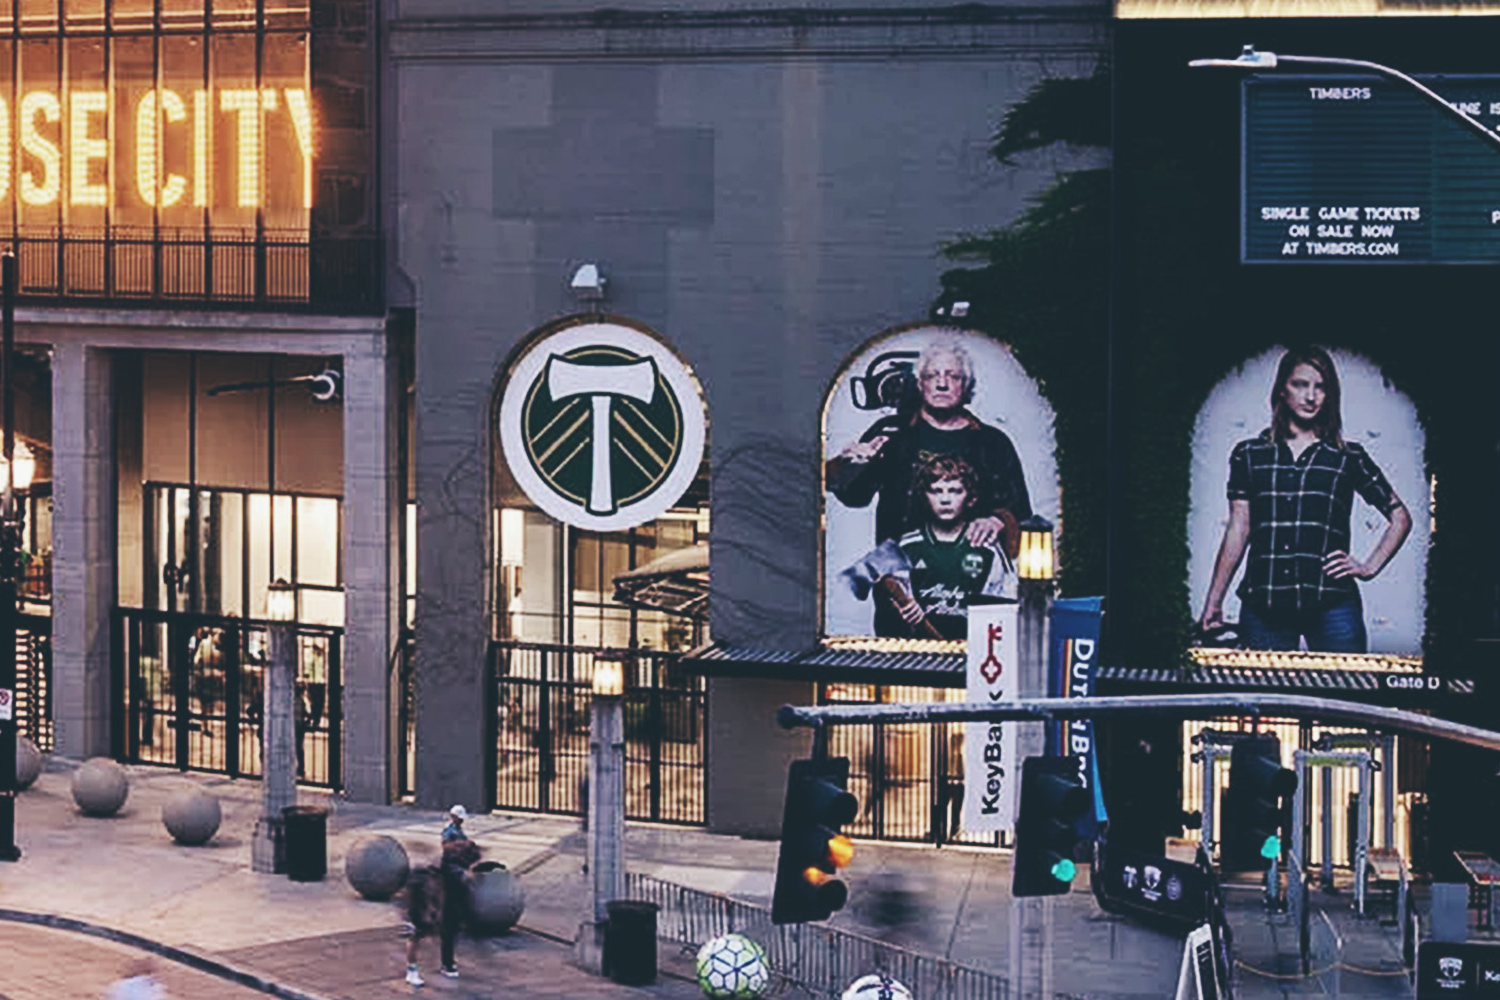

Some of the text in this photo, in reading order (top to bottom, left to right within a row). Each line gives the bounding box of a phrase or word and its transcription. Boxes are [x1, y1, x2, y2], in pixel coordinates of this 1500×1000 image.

[1309, 88, 1371, 99] TIMBERS
[136, 89, 319, 208] CITY
[1261, 207, 1420, 220] SINGLE GAME TICKETS
[1289, 225, 1394, 237] ON SALE NOW
[1282, 242, 1399, 255] AT TIMBERS.COM
